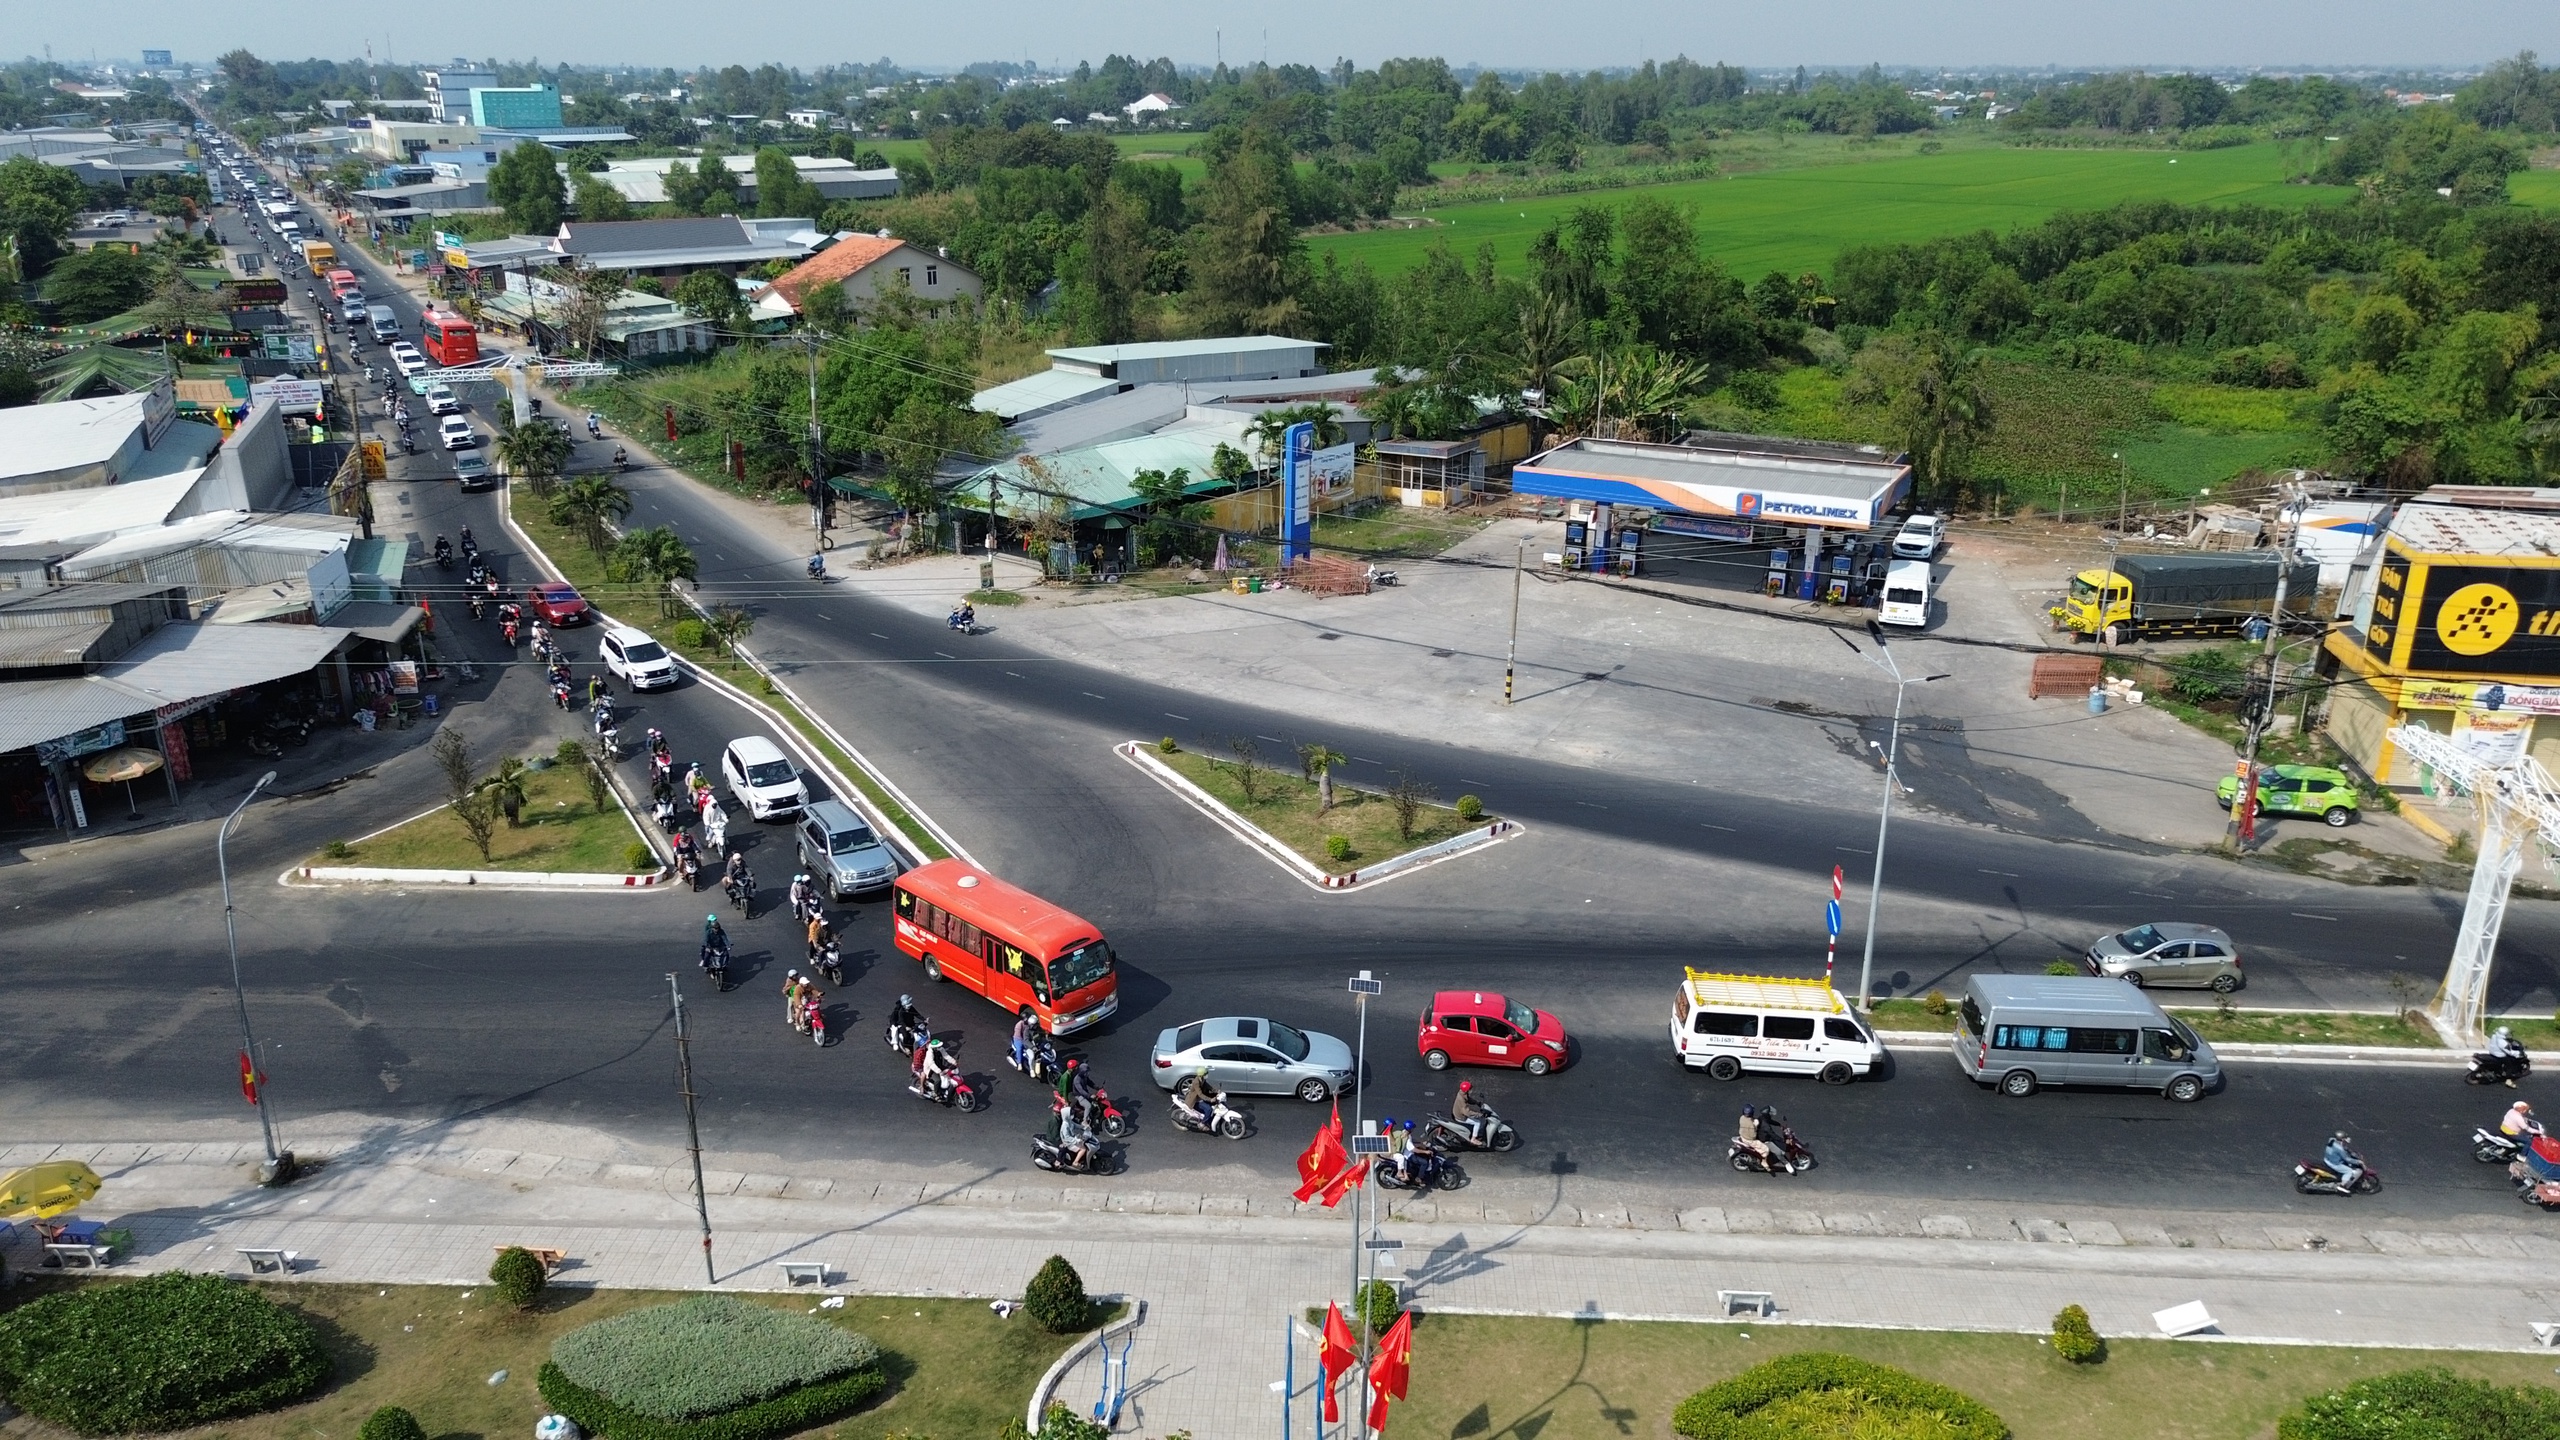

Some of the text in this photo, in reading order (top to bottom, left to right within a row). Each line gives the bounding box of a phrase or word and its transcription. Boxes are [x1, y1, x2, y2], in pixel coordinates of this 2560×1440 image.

[1764, 501, 1858, 519] PETROLIMEX
[2381, 566, 2402, 591] BÁN
[2376, 595, 2394, 621] TRẢ
[40, 1194, 75, 1210] BONCHA
